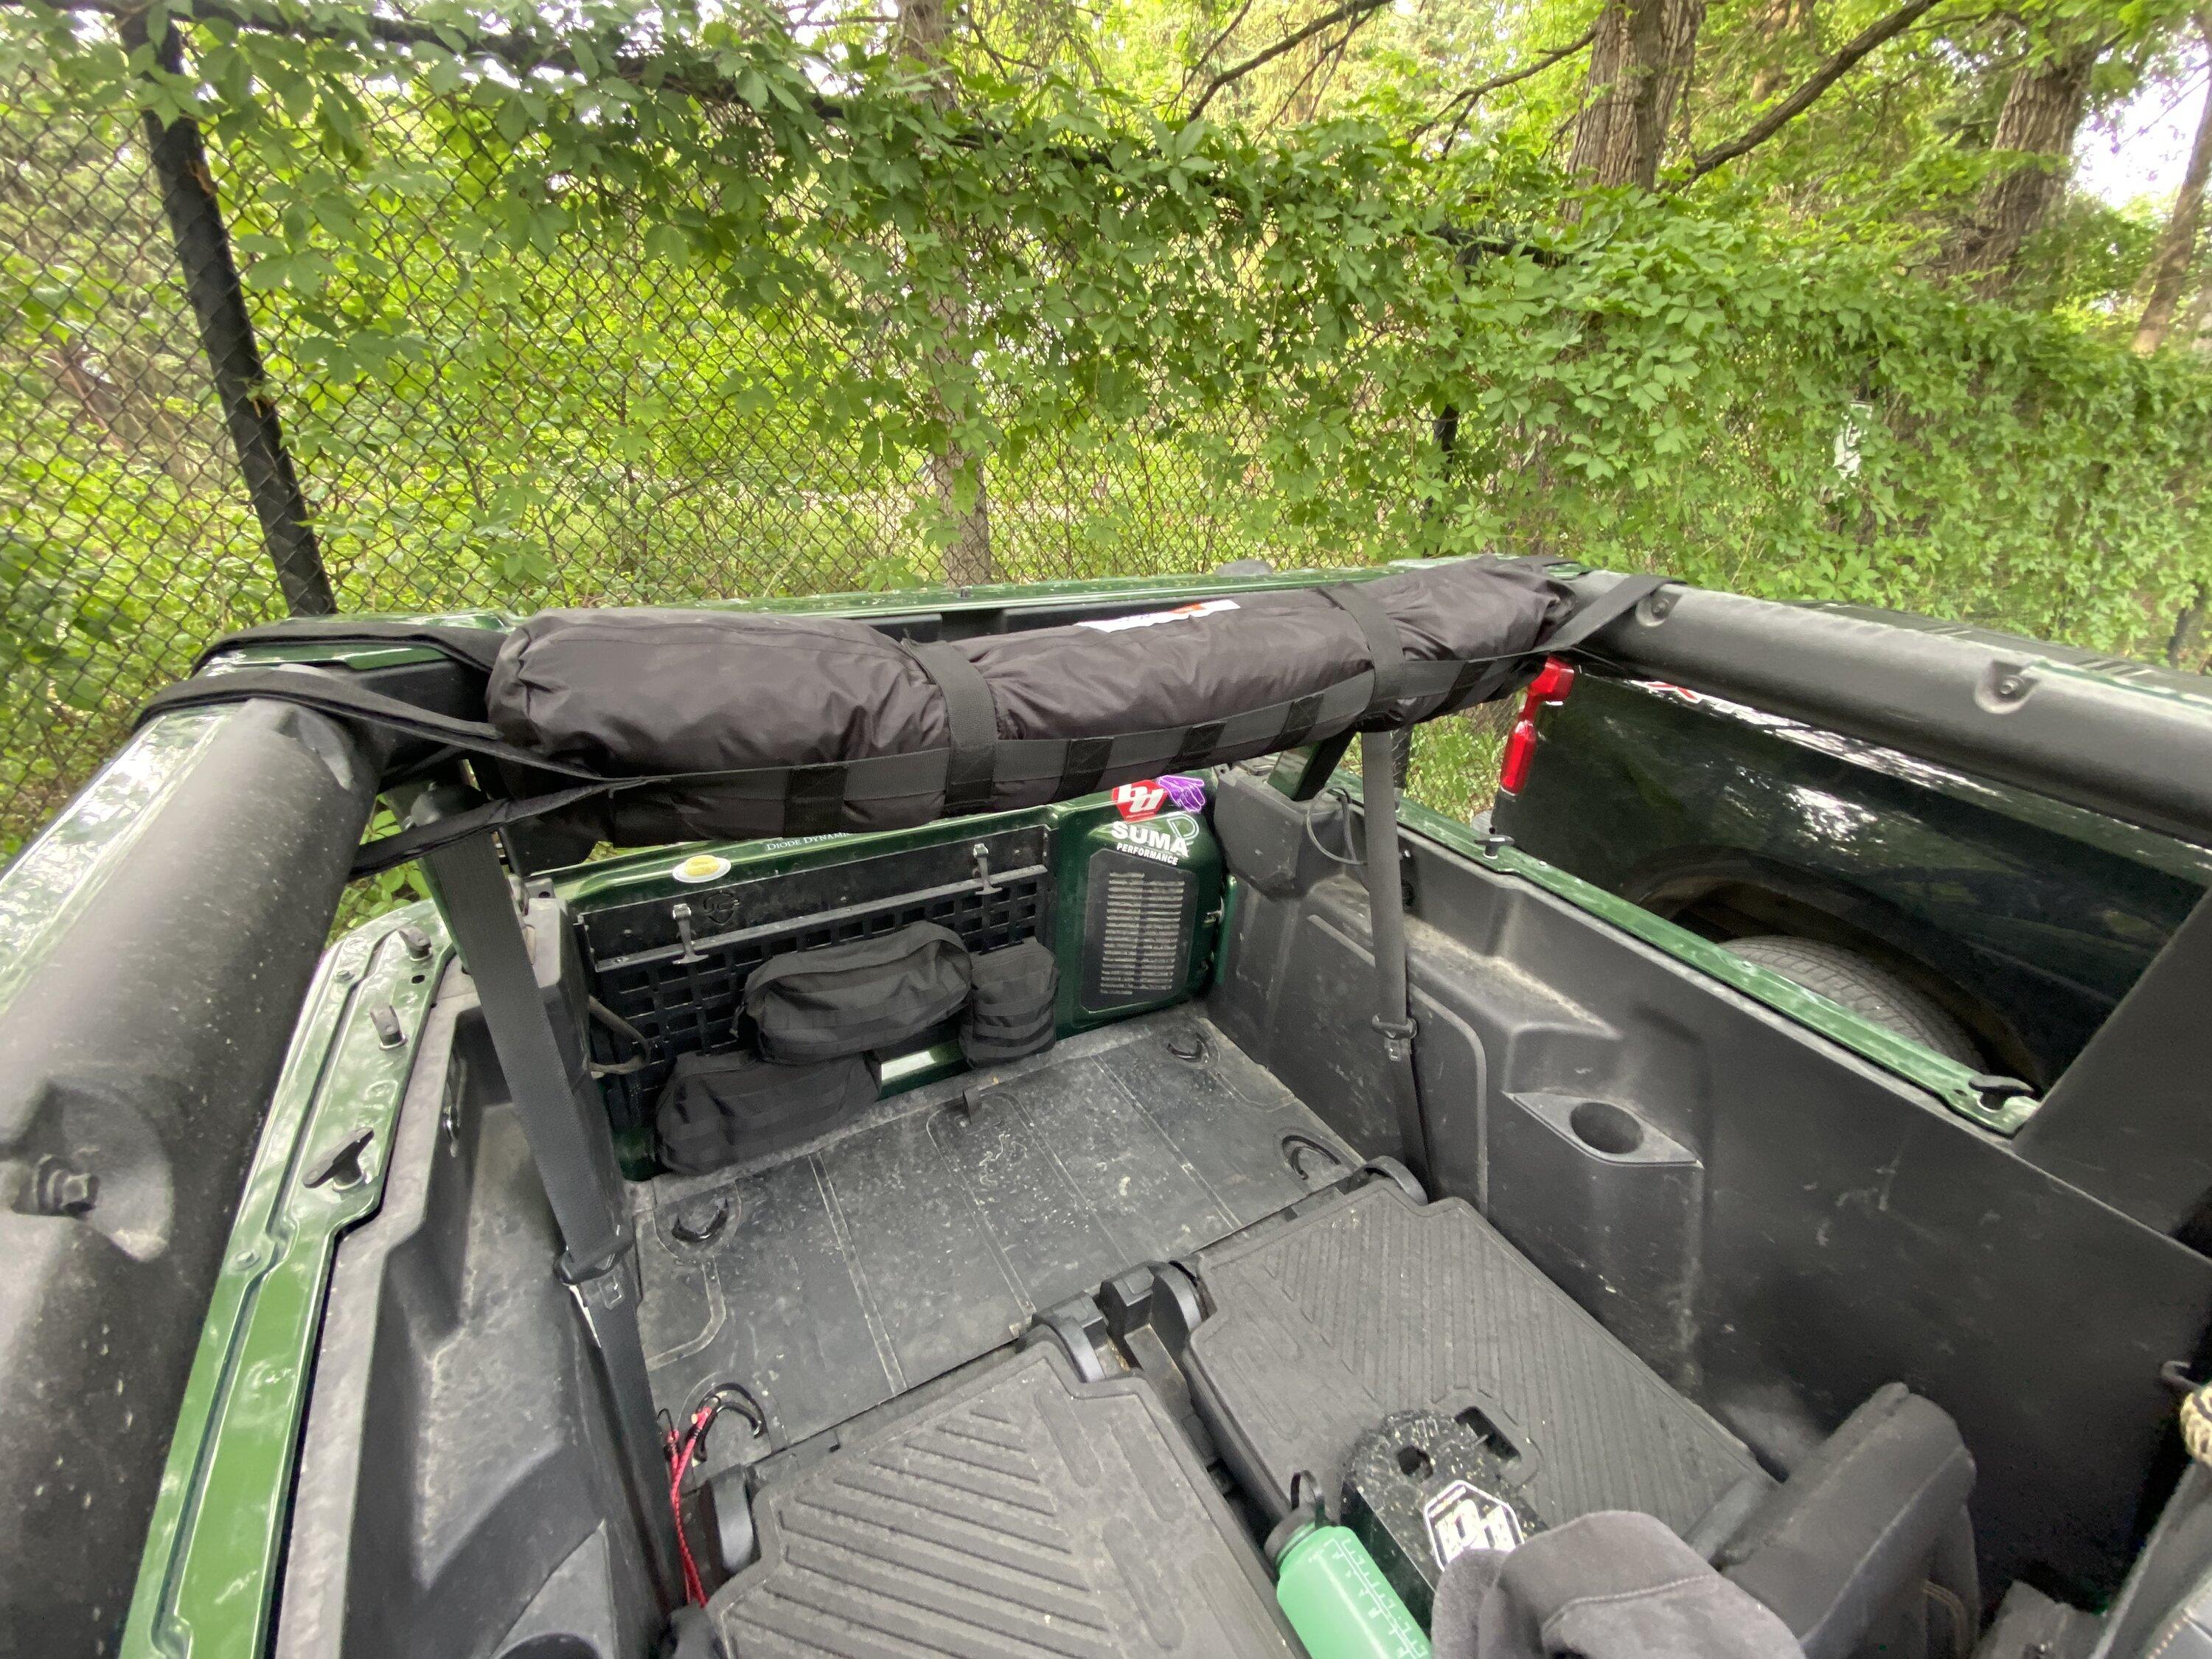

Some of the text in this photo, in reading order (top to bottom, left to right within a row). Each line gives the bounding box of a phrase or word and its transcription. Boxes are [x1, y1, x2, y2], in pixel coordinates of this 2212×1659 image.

[767, 839, 802, 850] DIODE
[1110, 821, 1189, 858] SUMA
[1116, 842, 1179, 866] PERFORMANCE
